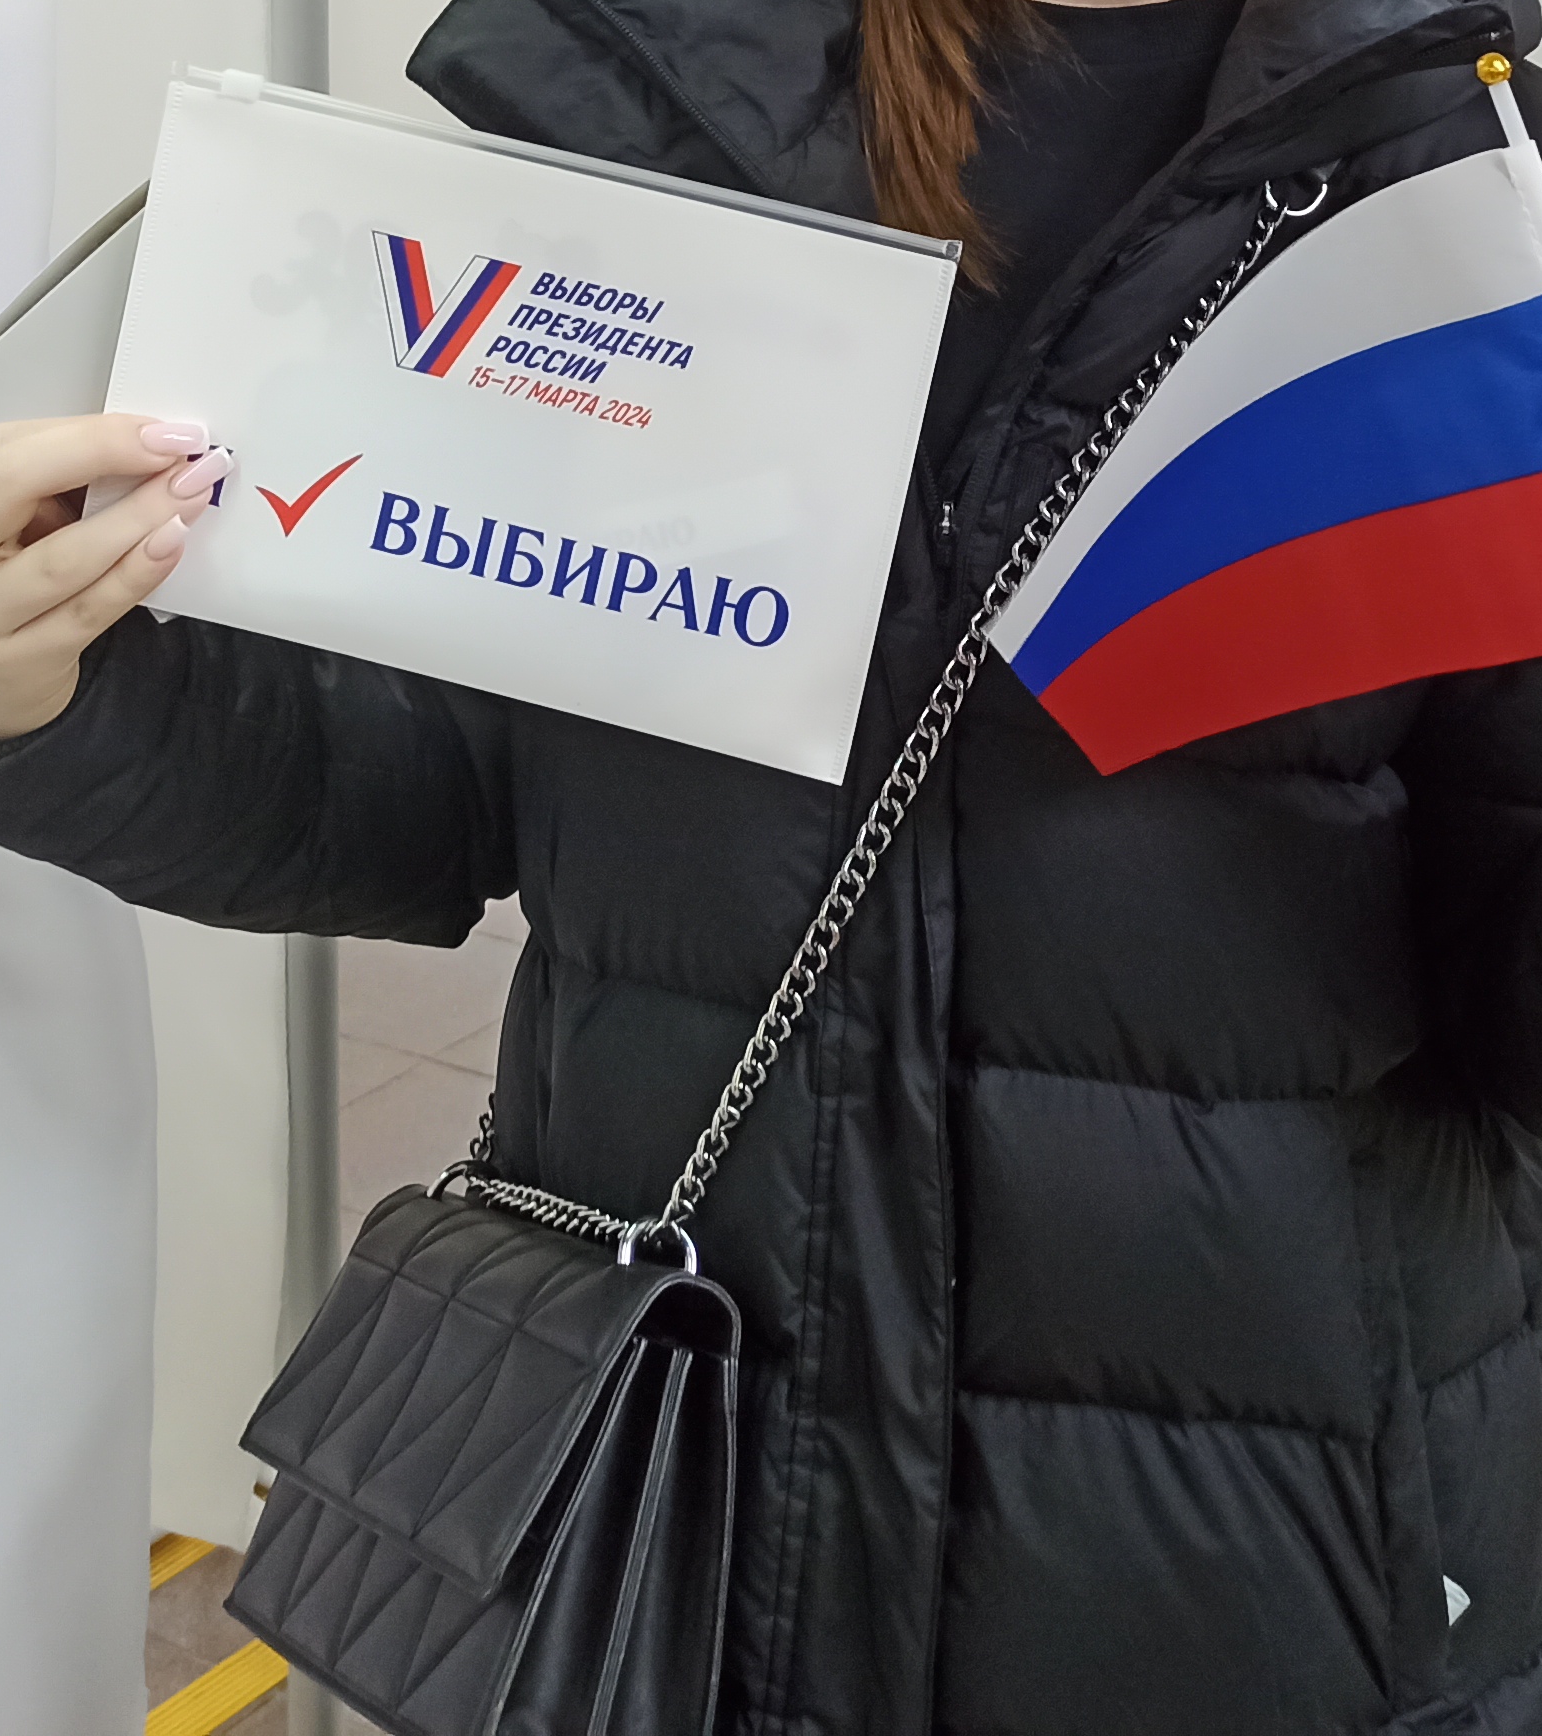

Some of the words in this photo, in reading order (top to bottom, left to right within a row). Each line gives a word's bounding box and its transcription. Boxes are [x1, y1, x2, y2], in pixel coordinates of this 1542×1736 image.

[530, 272, 664, 324] ВЫБОРЫ
[485, 335, 608, 384] РОССИИ
[507, 303, 695, 370] ПРЕЗИДЕНТА
[525, 380, 601, 416] МАРТА
[598, 399, 653, 430] 2024
[369, 491, 790, 648] ВЫБИРАЮ
